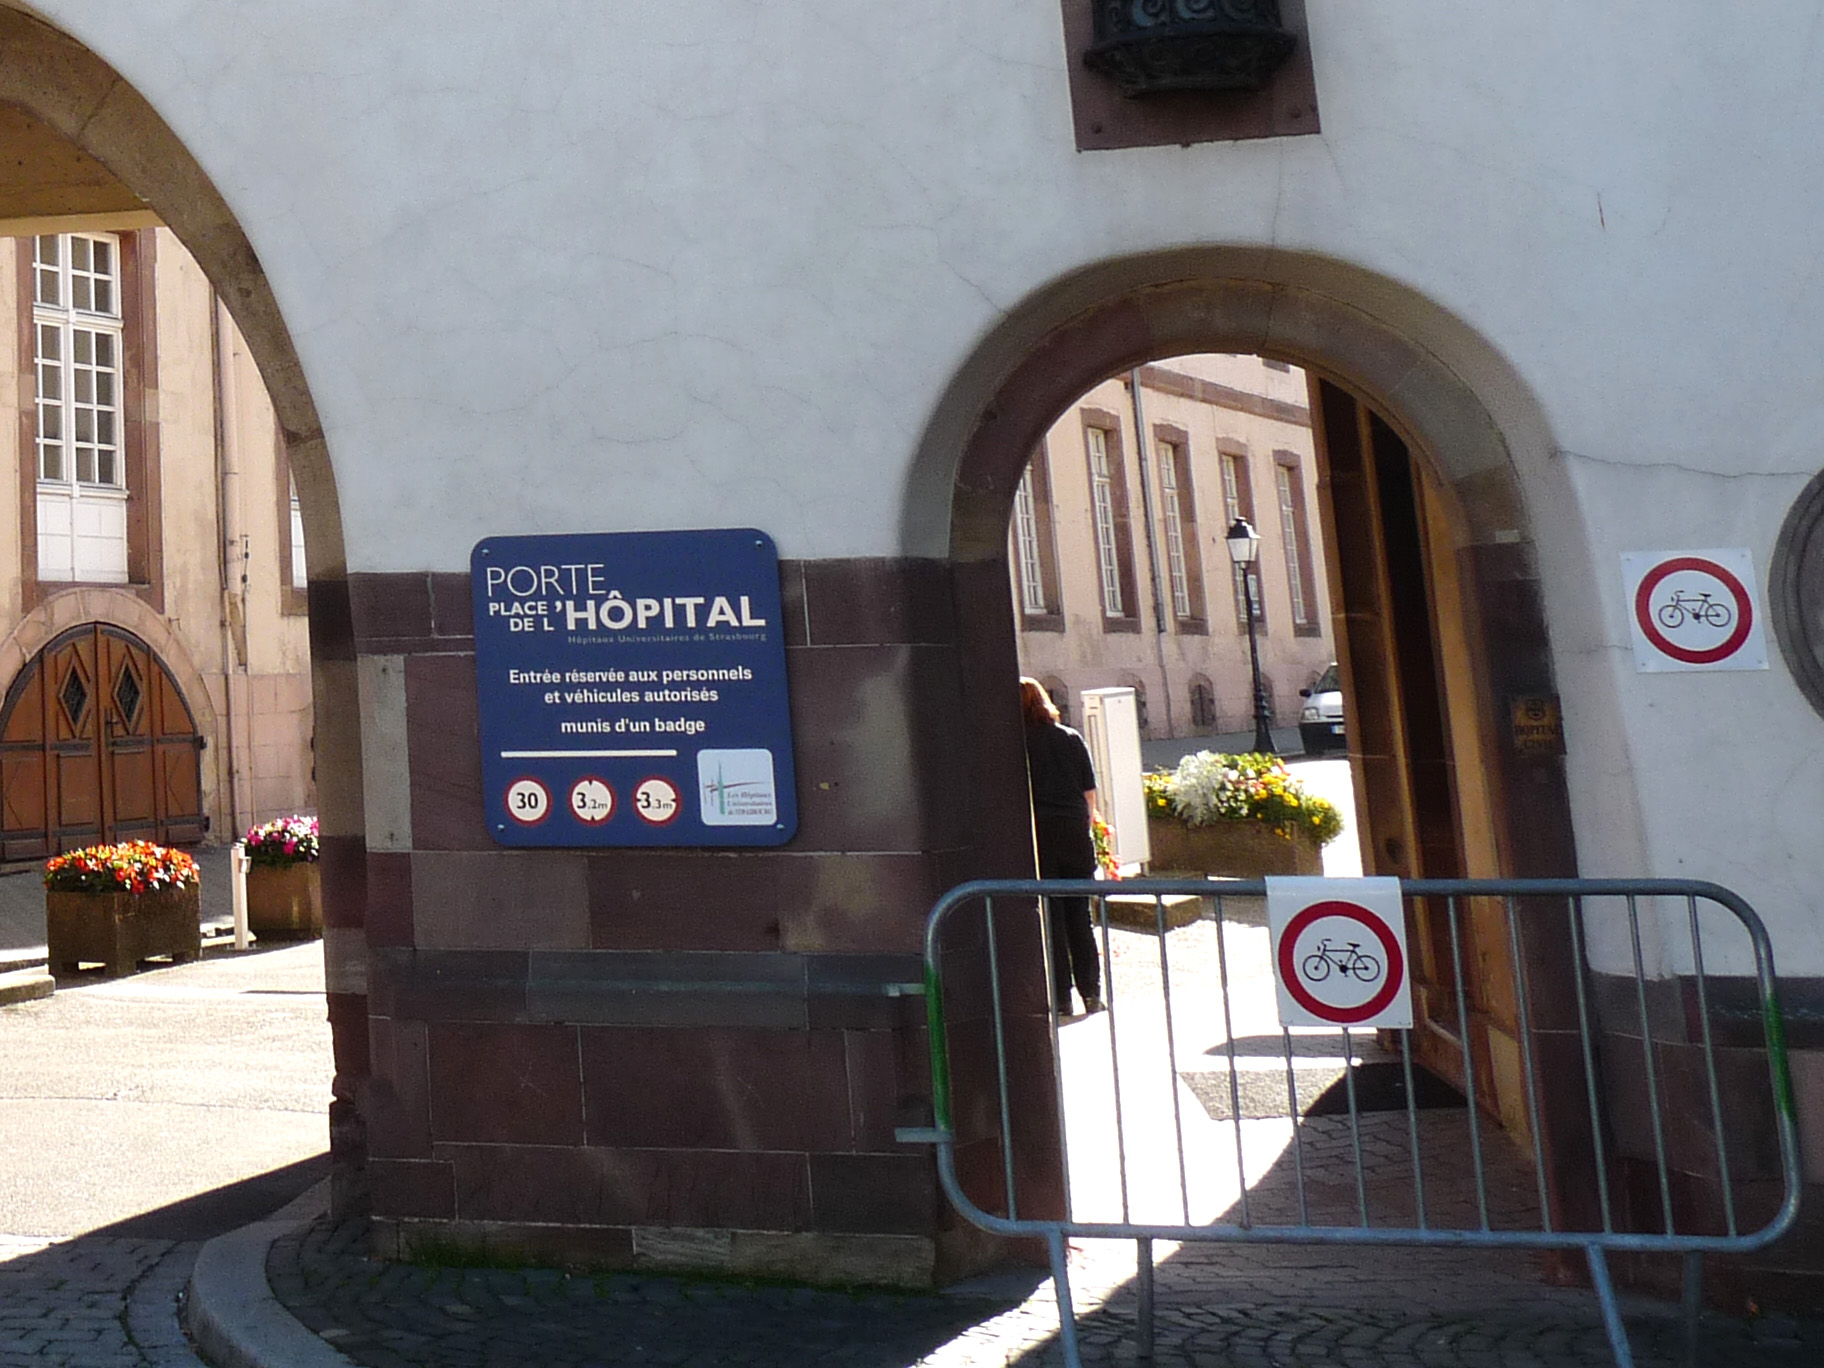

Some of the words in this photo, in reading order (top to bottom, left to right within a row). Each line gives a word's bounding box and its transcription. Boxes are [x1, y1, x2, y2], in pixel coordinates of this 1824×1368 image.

[486, 564, 607, 597] PORTE
[489, 602, 548, 615] PLACE
[510, 618, 534, 631] DE
[509, 669, 561, 683] Entrée
[565, 668, 625, 683] réservée
[629, 670, 657, 681] aux
[663, 666, 752, 683] personnels
[545, 690, 560, 703] et
[565, 689, 639, 703] véhicules
[644, 687, 718, 702] autorisés
[561, 719, 611, 733] munis
[615, 718, 650, 732] d'un
[655, 717, 705, 734] badge
[516, 792, 538, 809] 30
